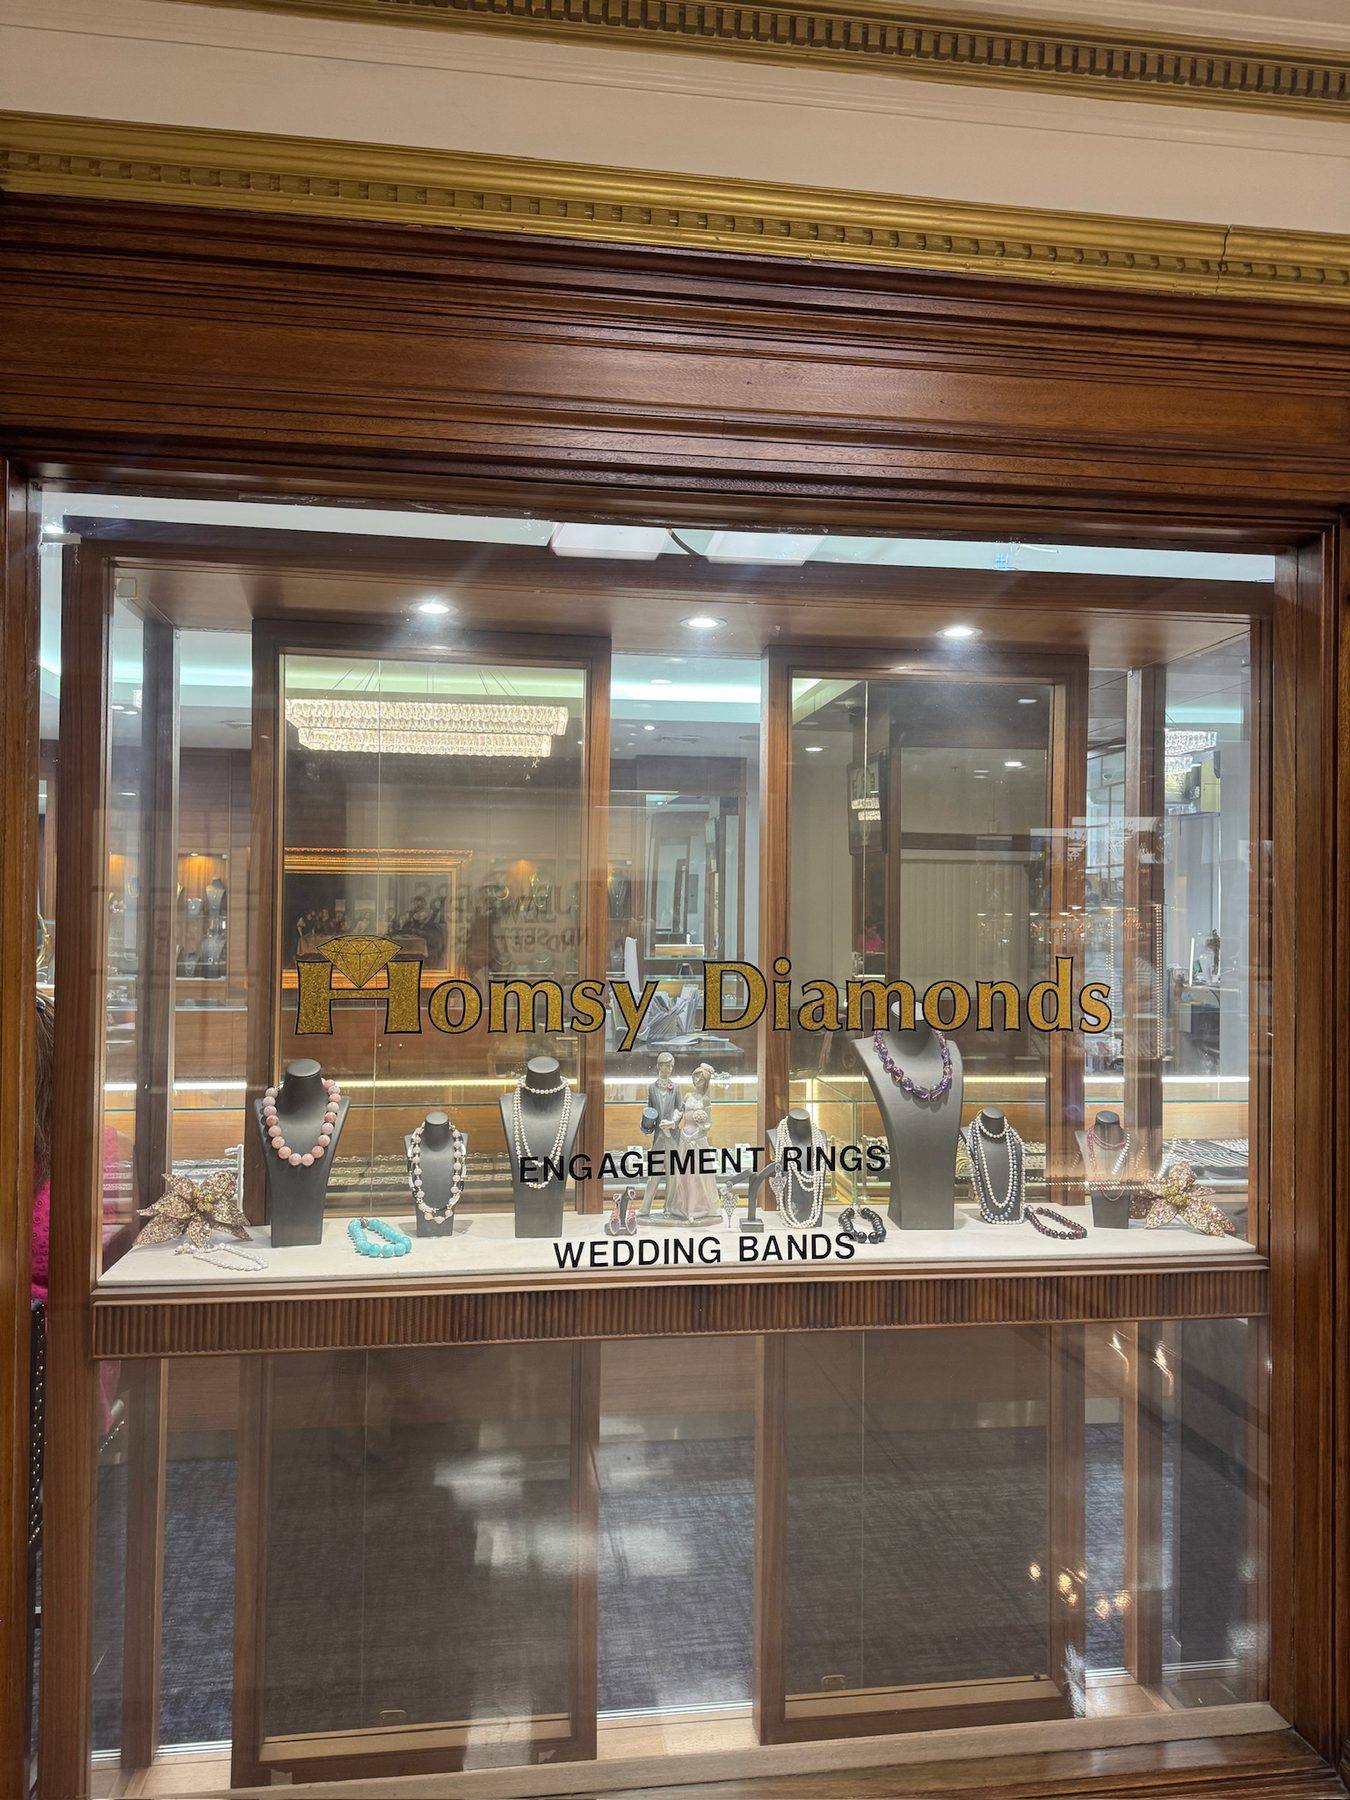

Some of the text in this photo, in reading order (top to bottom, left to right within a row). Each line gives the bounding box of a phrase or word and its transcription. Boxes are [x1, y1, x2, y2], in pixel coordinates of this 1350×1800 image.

[295, 956, 1112, 1052] Homsy Diamonds
[520, 1145, 887, 1183] ENGAGEMENT RINGS
[553, 1232, 855, 1269] WEDDING BANDS
